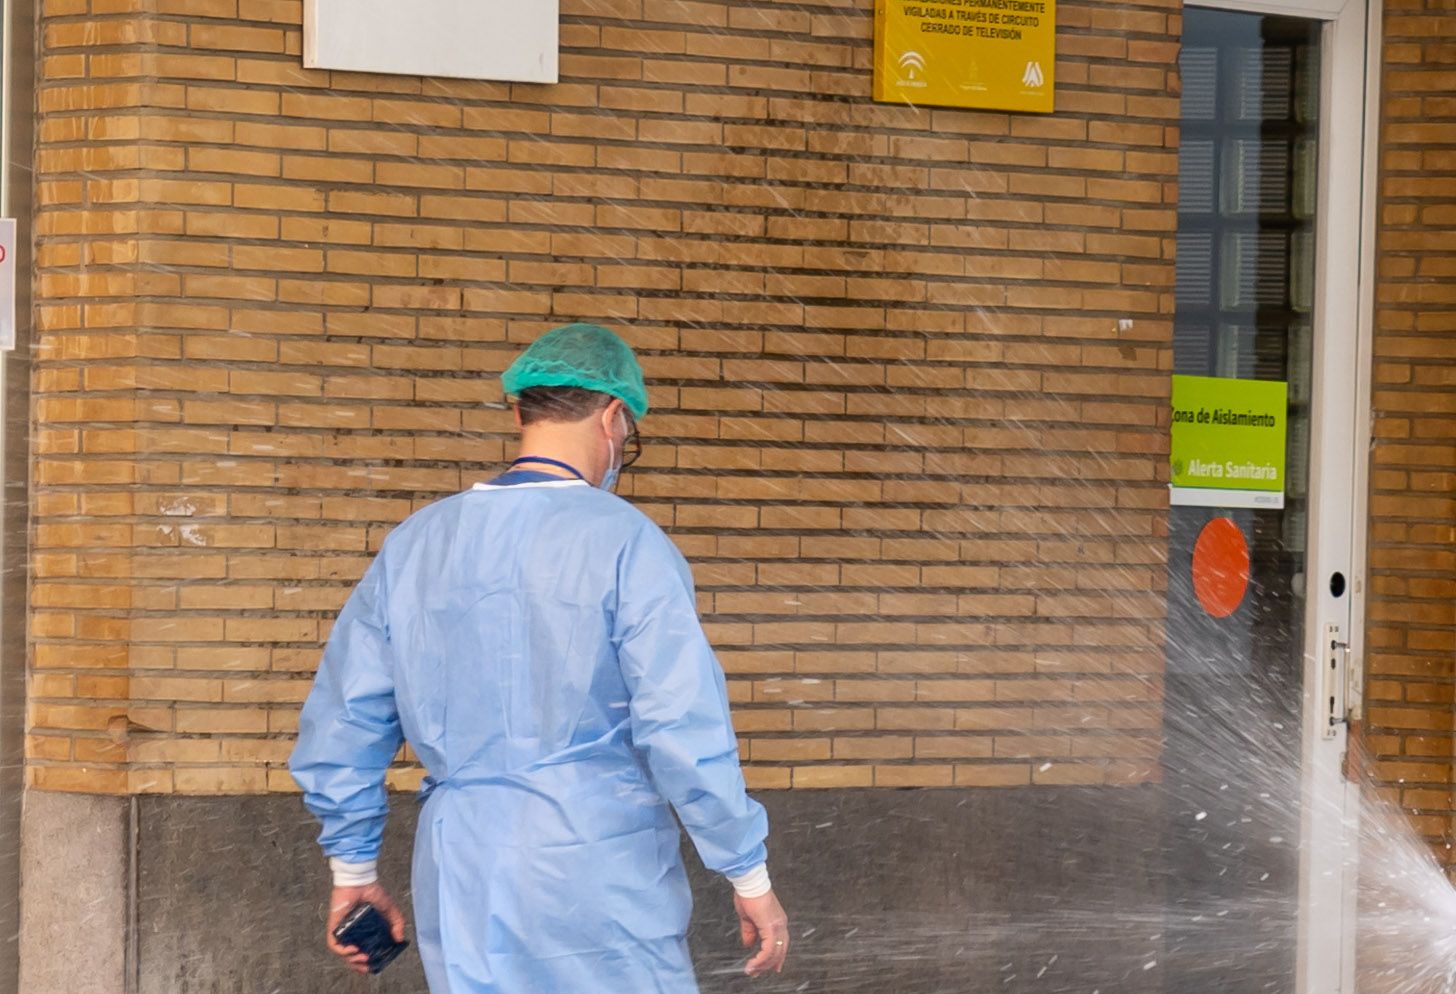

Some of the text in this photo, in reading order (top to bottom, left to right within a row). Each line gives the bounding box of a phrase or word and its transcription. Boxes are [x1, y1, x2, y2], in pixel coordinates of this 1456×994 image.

[903, 6, 1040, 27] VIGILADAS A TRAVÉS DE CIRCUITO
[963, 0, 1045, 13] PERMANENTEMENTE
[920, 22, 1022, 40] CERRADO DE TELEVISIÓN
[1197, 408, 1210, 424] de
[1211, 409, 1276, 428] Aislamiento
[1188, 459, 1278, 480] Alerta Sanitaria
